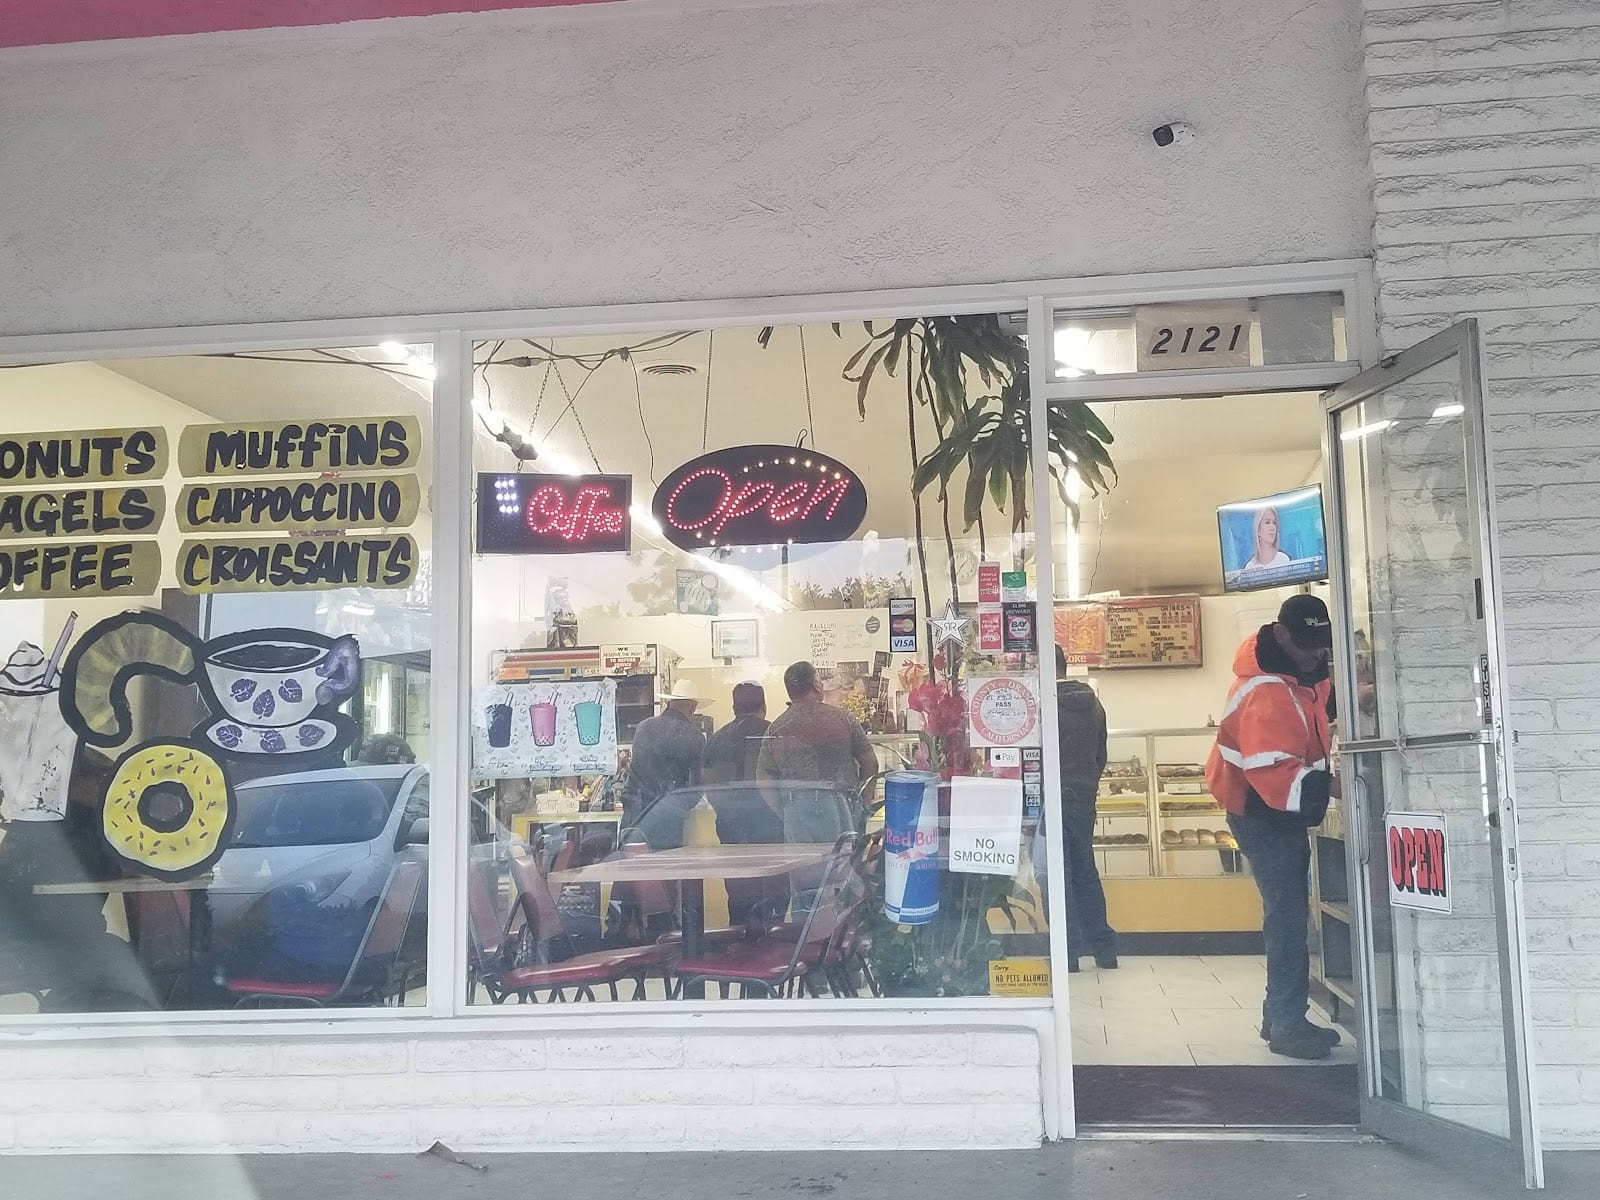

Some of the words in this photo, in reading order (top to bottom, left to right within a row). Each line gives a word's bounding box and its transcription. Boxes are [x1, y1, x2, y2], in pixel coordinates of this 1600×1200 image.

[1151, 324, 1242, 354] 2121
[0, 430, 157, 478] ONUTS
[0, 488, 156, 536] AGELS
[186, 481, 401, 525] CAPPOCCINO
[667, 468, 850, 536] Open
[0, 543, 134, 592] OFFEE
[184, 536, 412, 586] CROISSANTS
[894, 639, 914, 648] VISA
[971, 682, 996, 714] COUNTY
[1481, 658, 1490, 708] PUSH
[980, 727, 1029, 743] CALIFORNIA
[1002, 752, 1016, 760] Pay
[886, 828, 912, 847] Red
[914, 827, 937, 847] Bull
[976, 838, 995, 849] NO
[954, 851, 1016, 865] SMOKING
[1389, 826, 1447, 897] OPEN
[996, 974, 1004, 983] NO
[1006, 974, 1020, 983] PETS
[1022, 973, 1049, 982] ALLOWED
